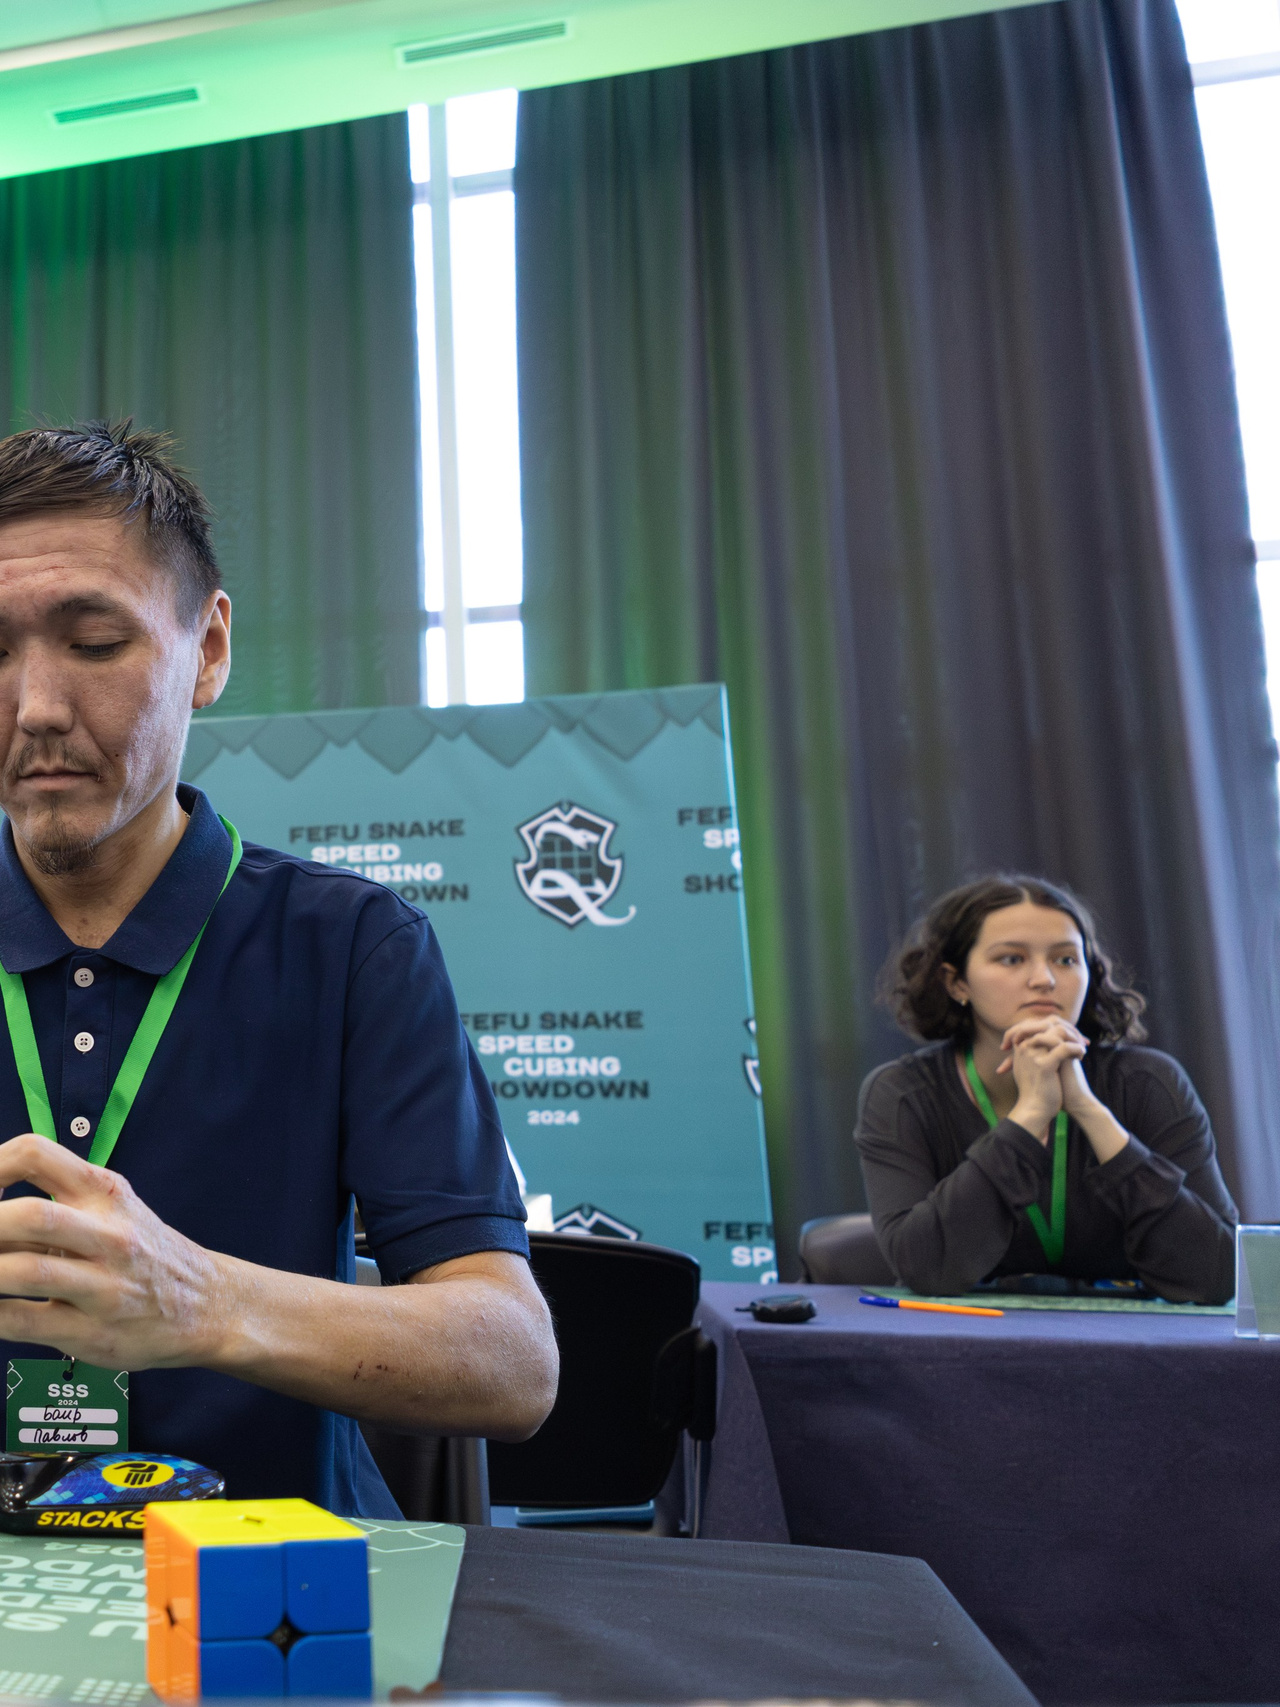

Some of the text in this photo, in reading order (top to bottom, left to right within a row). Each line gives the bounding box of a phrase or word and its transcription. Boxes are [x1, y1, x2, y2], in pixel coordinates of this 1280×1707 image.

[288, 818, 465, 843] FEFU SNAKE
[310, 843, 401, 864] SPEED
[341, 862, 444, 883] UBING
[396, 884, 469, 902] OWN
[538, 1010, 644, 1031] SNAKE
[477, 1034, 575, 1055] SPEED
[503, 1056, 622, 1077] CUBING
[527, 1110, 580, 1125] 2024
[47, 1383, 89, 1398] SSS
[33, 1425, 88, 1444] Павлов
[36, 1510, 147, 1530] STACKS
[43, 1541, 144, 1557] 024
